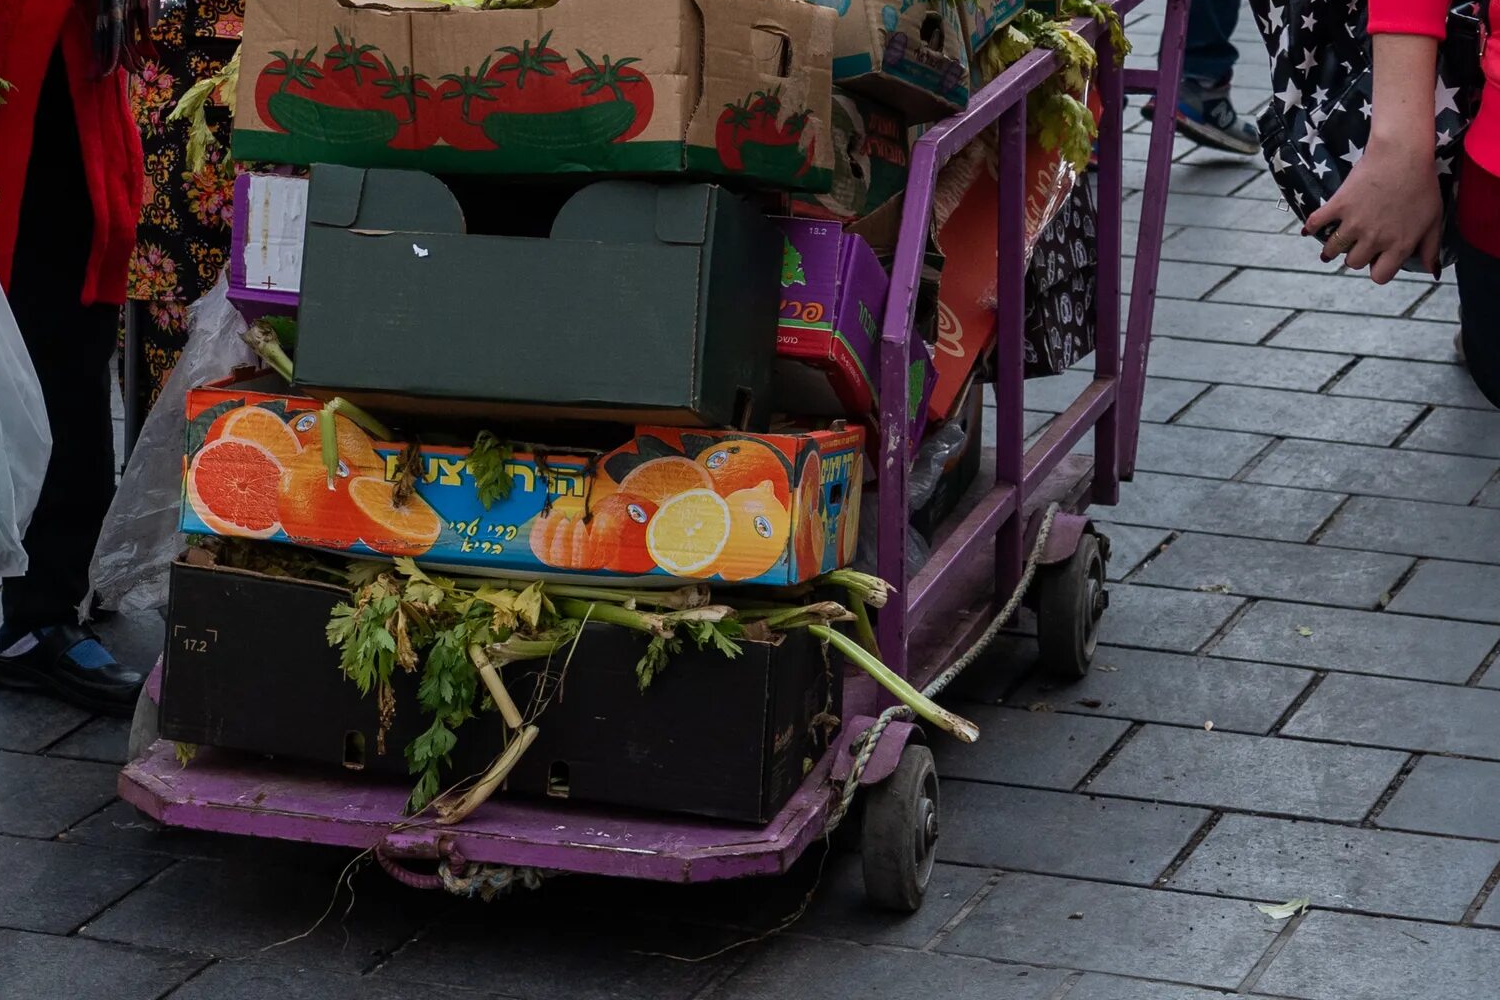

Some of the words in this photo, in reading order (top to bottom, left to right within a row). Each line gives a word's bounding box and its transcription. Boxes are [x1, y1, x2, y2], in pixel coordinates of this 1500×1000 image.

[449, 516, 481, 536] טרי
[487, 523, 518, 541] פרי
[183, 638, 208, 653] 17.2
